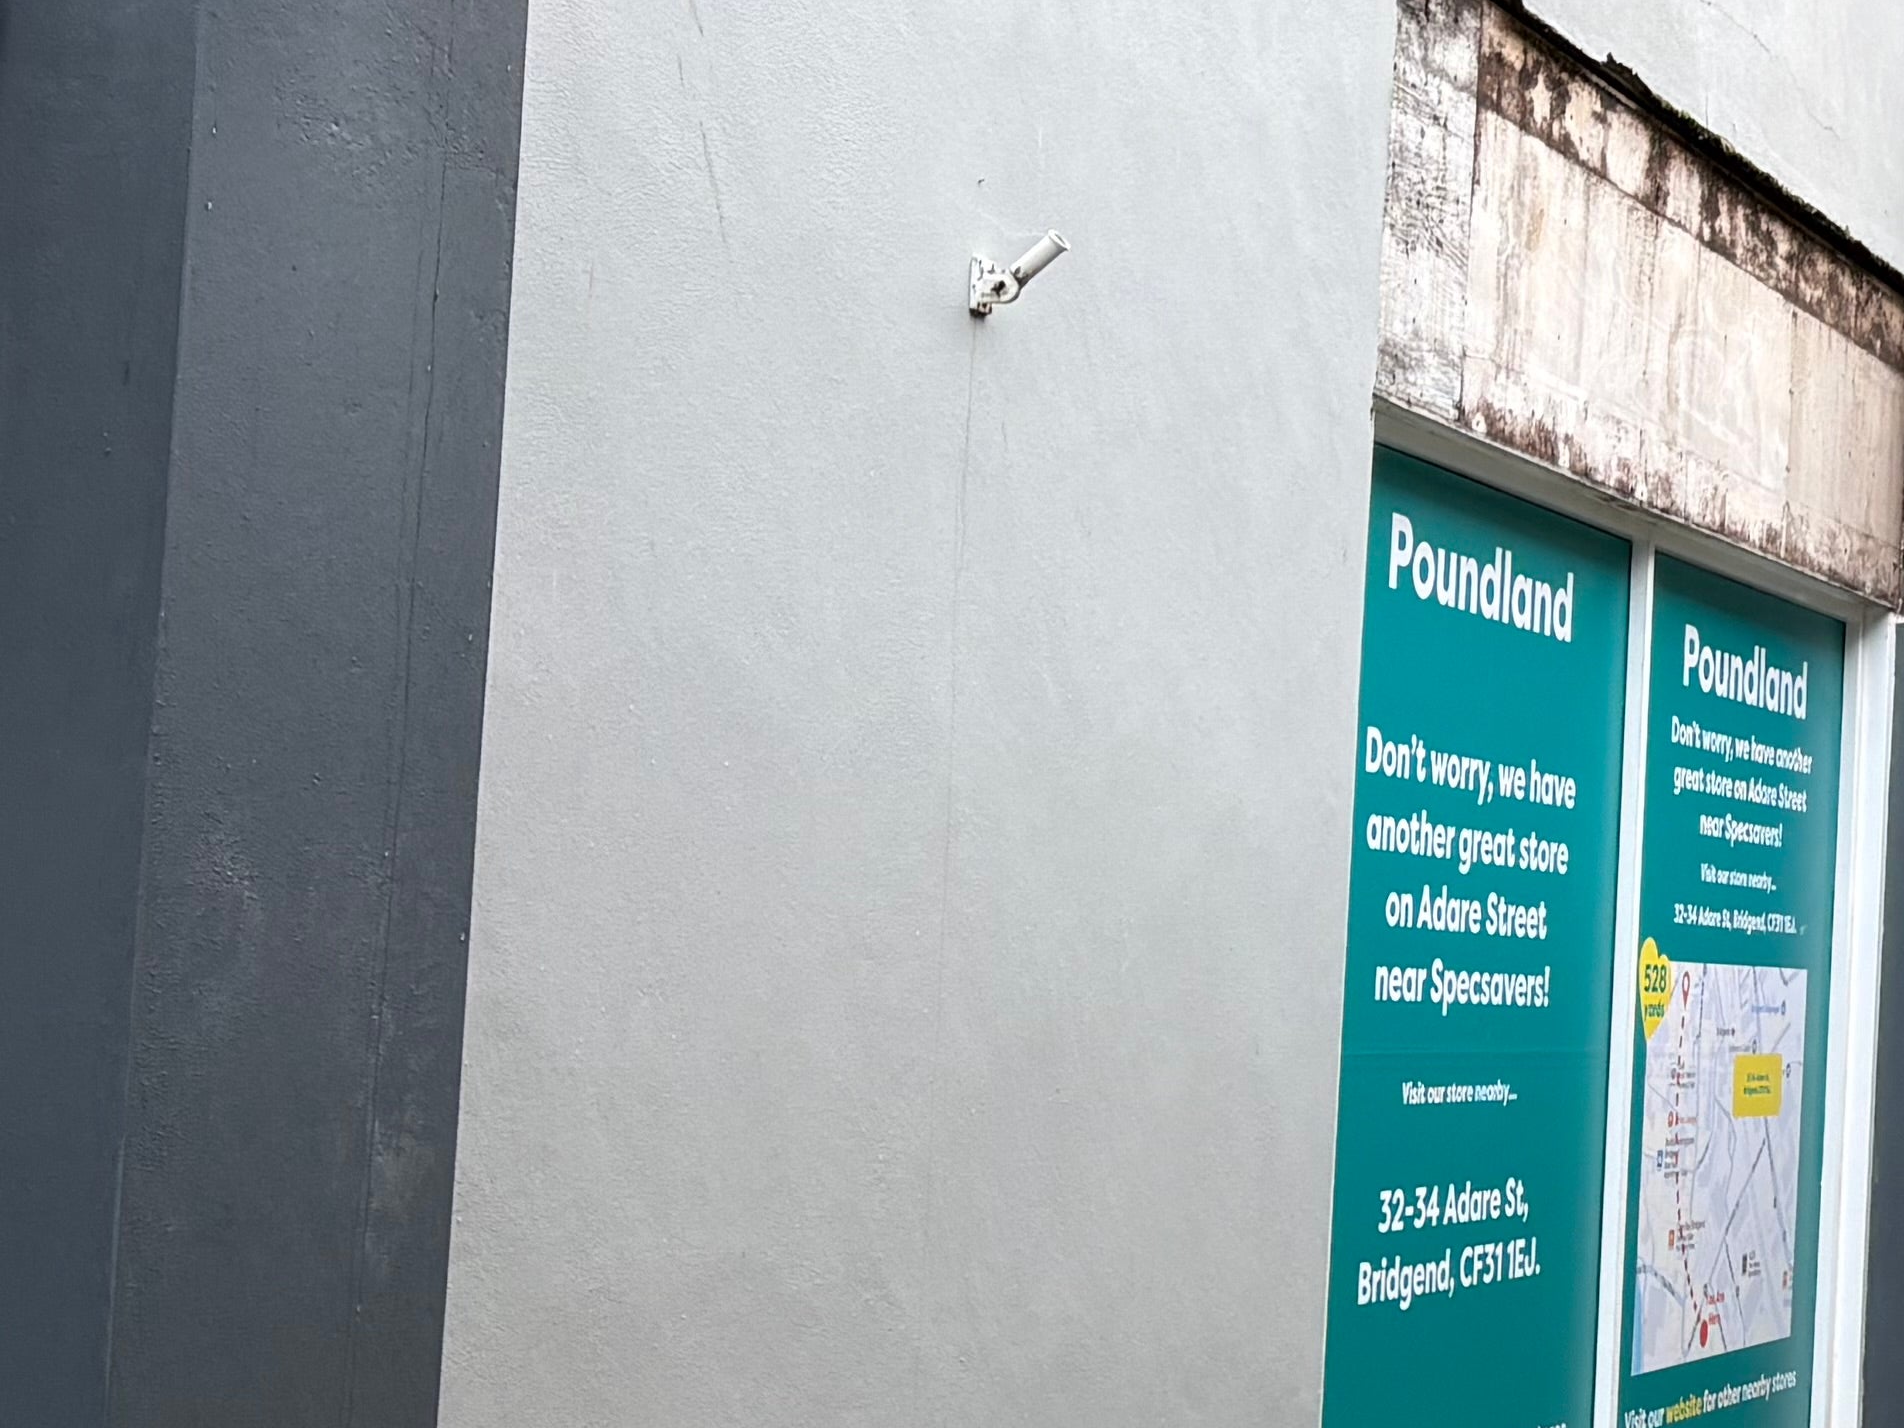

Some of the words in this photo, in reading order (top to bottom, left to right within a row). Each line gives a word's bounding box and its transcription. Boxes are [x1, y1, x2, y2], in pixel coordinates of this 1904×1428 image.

[1388, 512, 1574, 642] Poundland
[1683, 624, 1808, 720] Poundland
[1365, 726, 1427, 782] Don't
[1430, 750, 1494, 804] worry,
[1498, 764, 1526, 800] we
[1529, 759, 1576, 809] have
[1671, 715, 1701, 749] Don't
[1702, 730, 1734, 759] worry,
[1735, 738, 1751, 760] we
[1750, 735, 1775, 766] have
[1673, 766, 1705, 795] great
[1705, 771, 1733, 798] store
[1733, 779, 1747, 801] on
[1747, 778, 1778, 807] Adare
[1777, 783, 1807, 813] Street
[1366, 812, 1456, 859] another
[1458, 828, 1516, 874] great
[1519, 832, 1569, 875] store
[1700, 814, 1724, 838] near
[1385, 892, 1414, 928] on
[1416, 884, 1482, 934] Adare
[1485, 891, 1547, 940] Street
[1375, 966, 1427, 1002] near
[1430, 958, 1551, 1016] Specsavers!
[1644, 963, 1667, 993] 528
[1402, 1081, 1426, 1105] Visit
[1427, 1086, 1446, 1104] our
[1446, 1083, 1474, 1103] store
[1378, 1185, 1440, 1233] 32-34
[1443, 1181, 1502, 1225] Adare
[1504, 1177, 1529, 1222] St,
[1357, 1248, 1455, 1310] Bridgend,
[1460, 1242, 1503, 1287] CF31
[1507, 1237, 1541, 1279] 1EJ.
[1647, 1408, 1665, 1428] our
[1666, 1394, 1702, 1423] website
[1703, 1389, 1717, 1413] for
[1717, 1384, 1742, 1409] other
[1742, 1375, 1772, 1400] nearby
